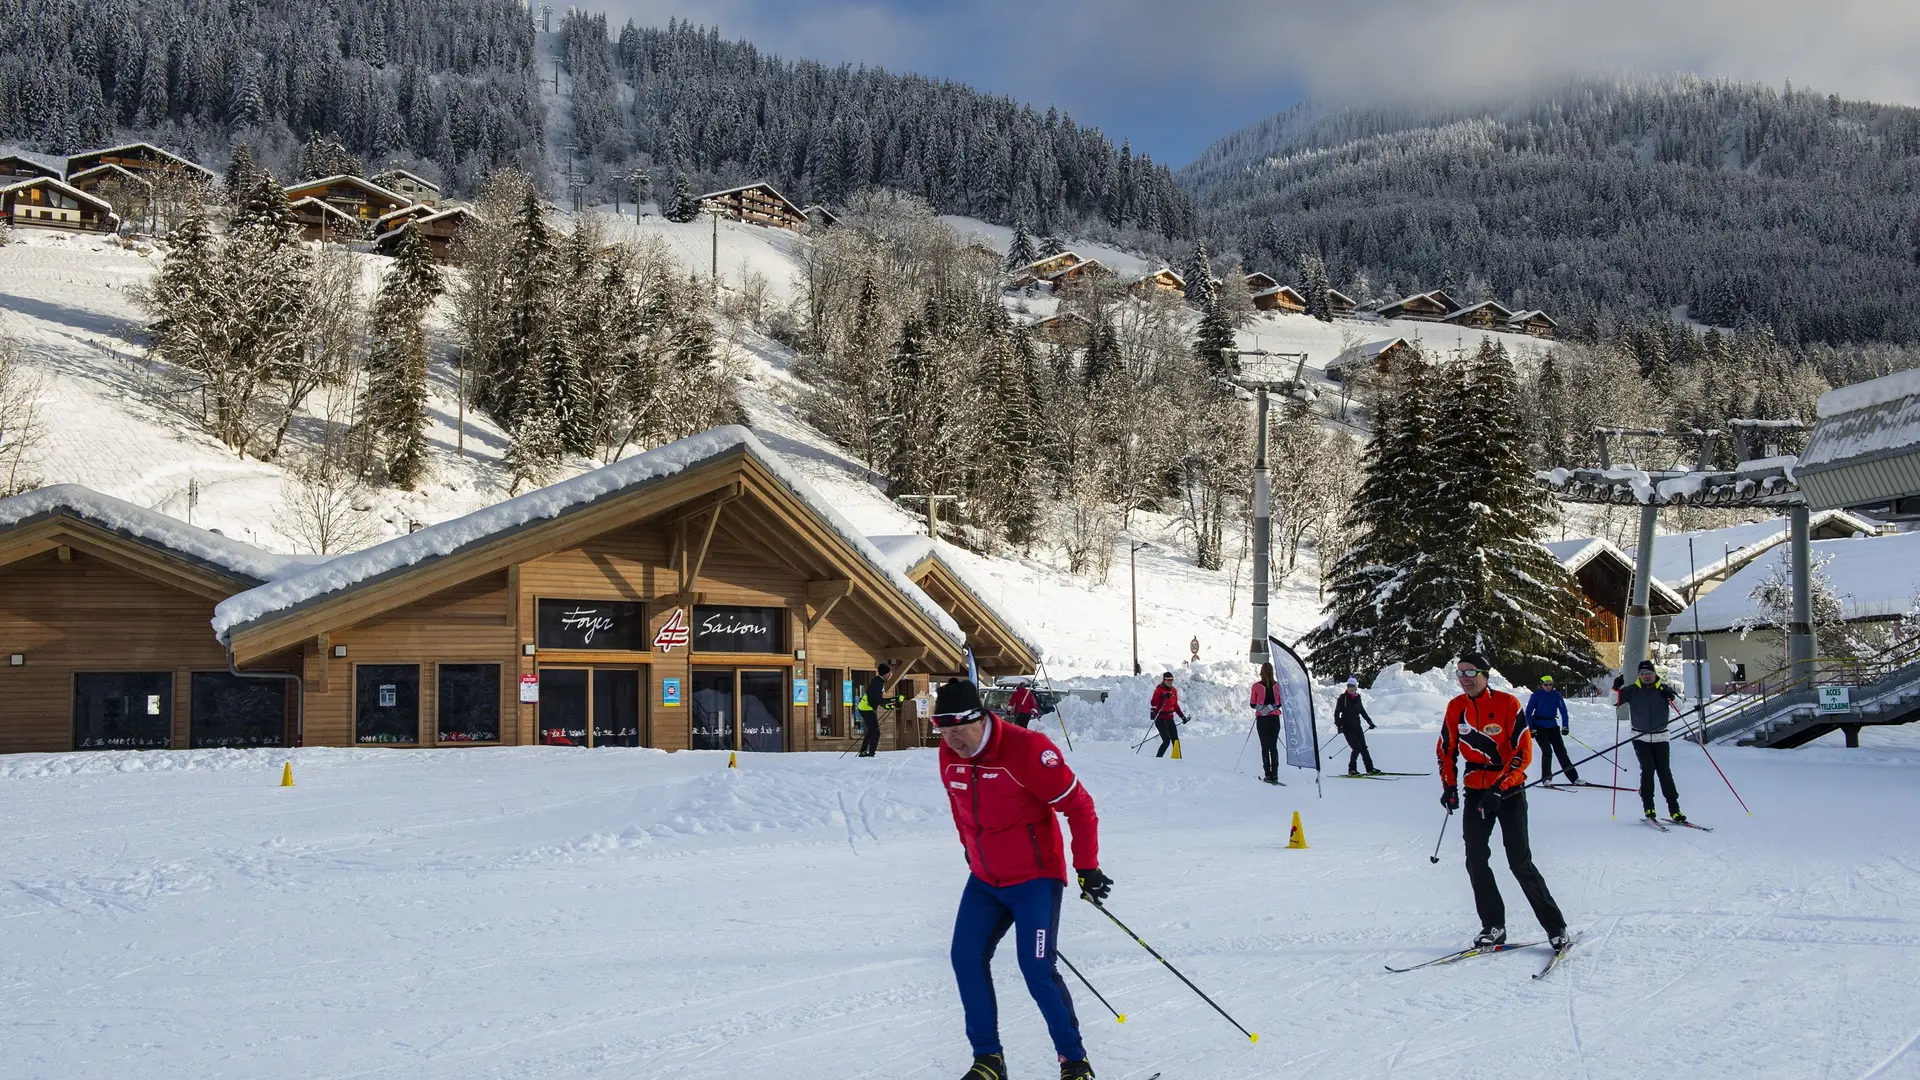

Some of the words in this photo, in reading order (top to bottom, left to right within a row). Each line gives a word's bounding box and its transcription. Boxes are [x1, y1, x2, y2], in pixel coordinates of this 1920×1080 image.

[562, 606, 614, 644] Foyer
[654, 608, 690, 653] 4
[700, 613, 766, 636] Saisons
[1821, 702, 1849, 710] TELECABINE
